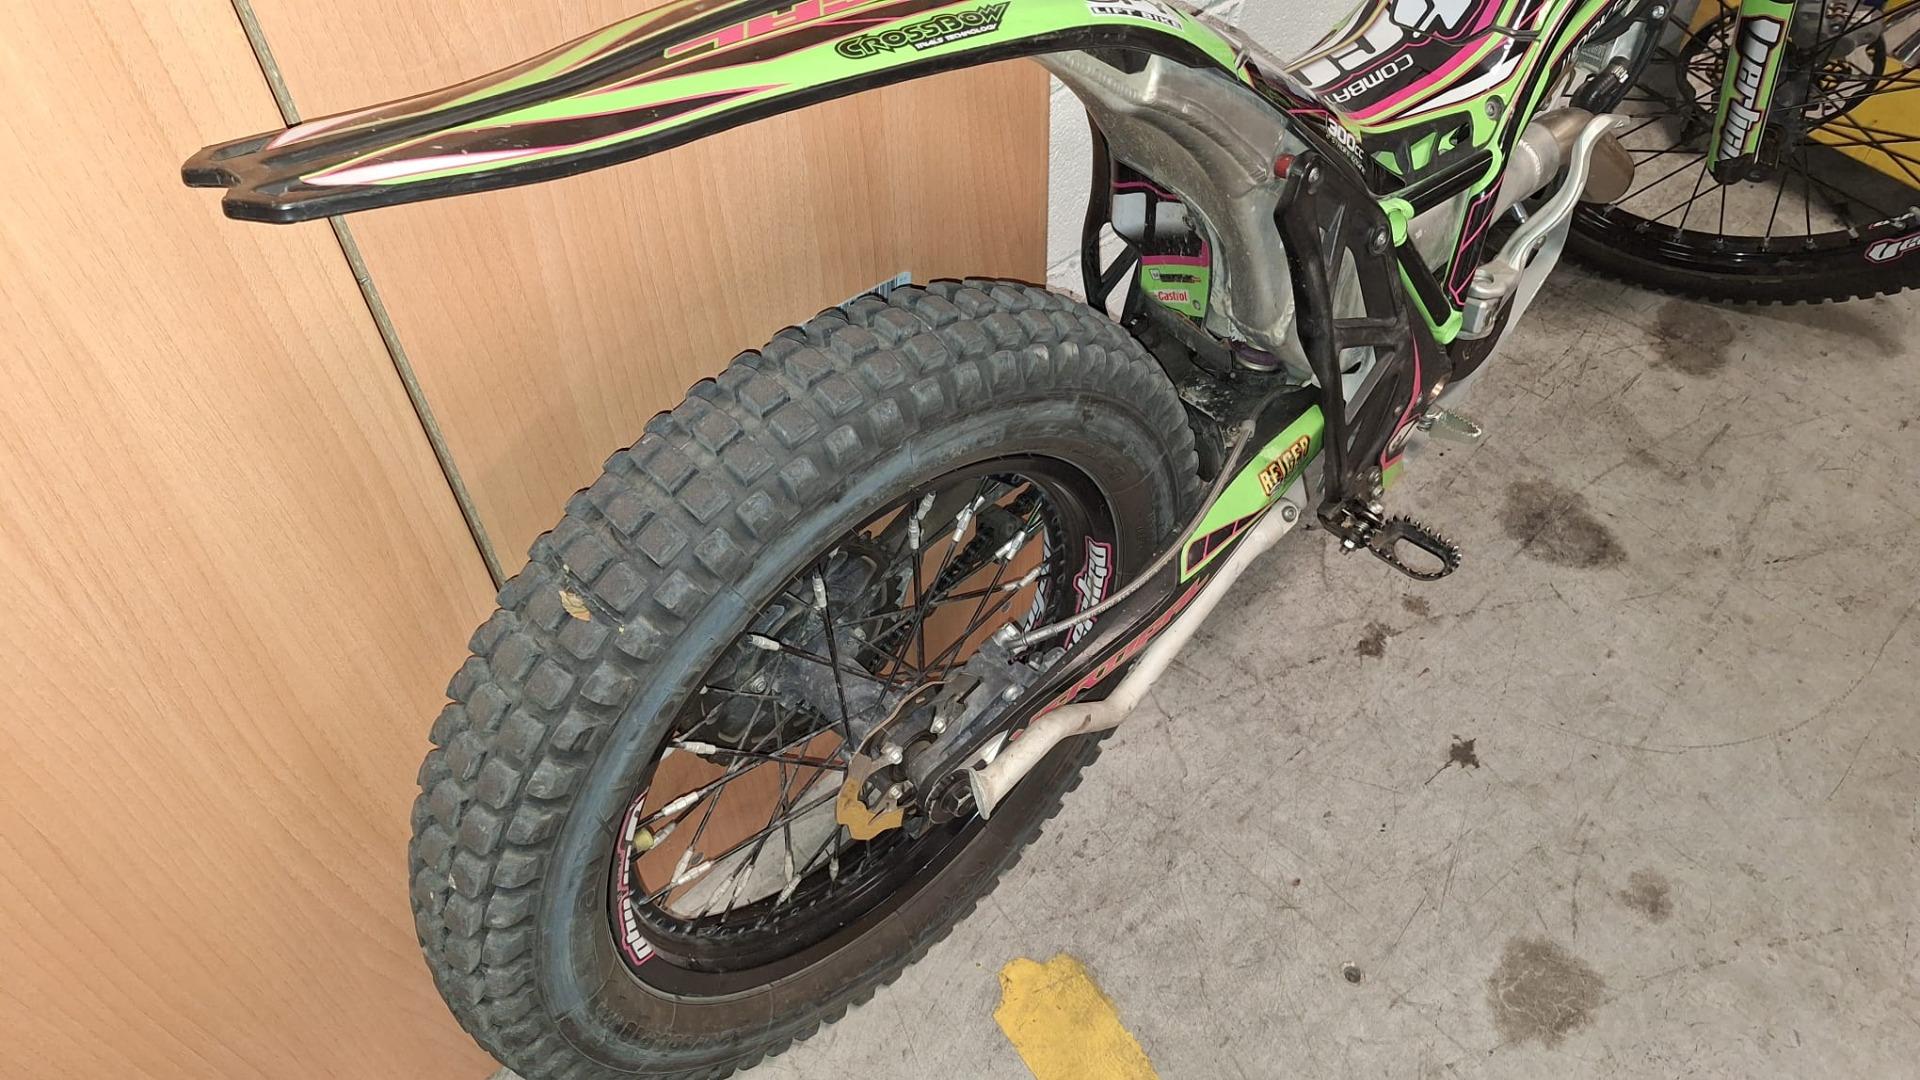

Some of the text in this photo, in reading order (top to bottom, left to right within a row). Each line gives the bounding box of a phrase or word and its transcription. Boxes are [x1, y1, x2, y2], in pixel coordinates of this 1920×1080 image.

[1092, 6, 1134, 16] LIFT
[1140, 11, 1182, 30] BIKE
[835, 2, 1011, 59] CROSSBOW
[945, 23, 998, 41] TECHNOLOGY
[1157, 290, 1188, 302] Castrol
